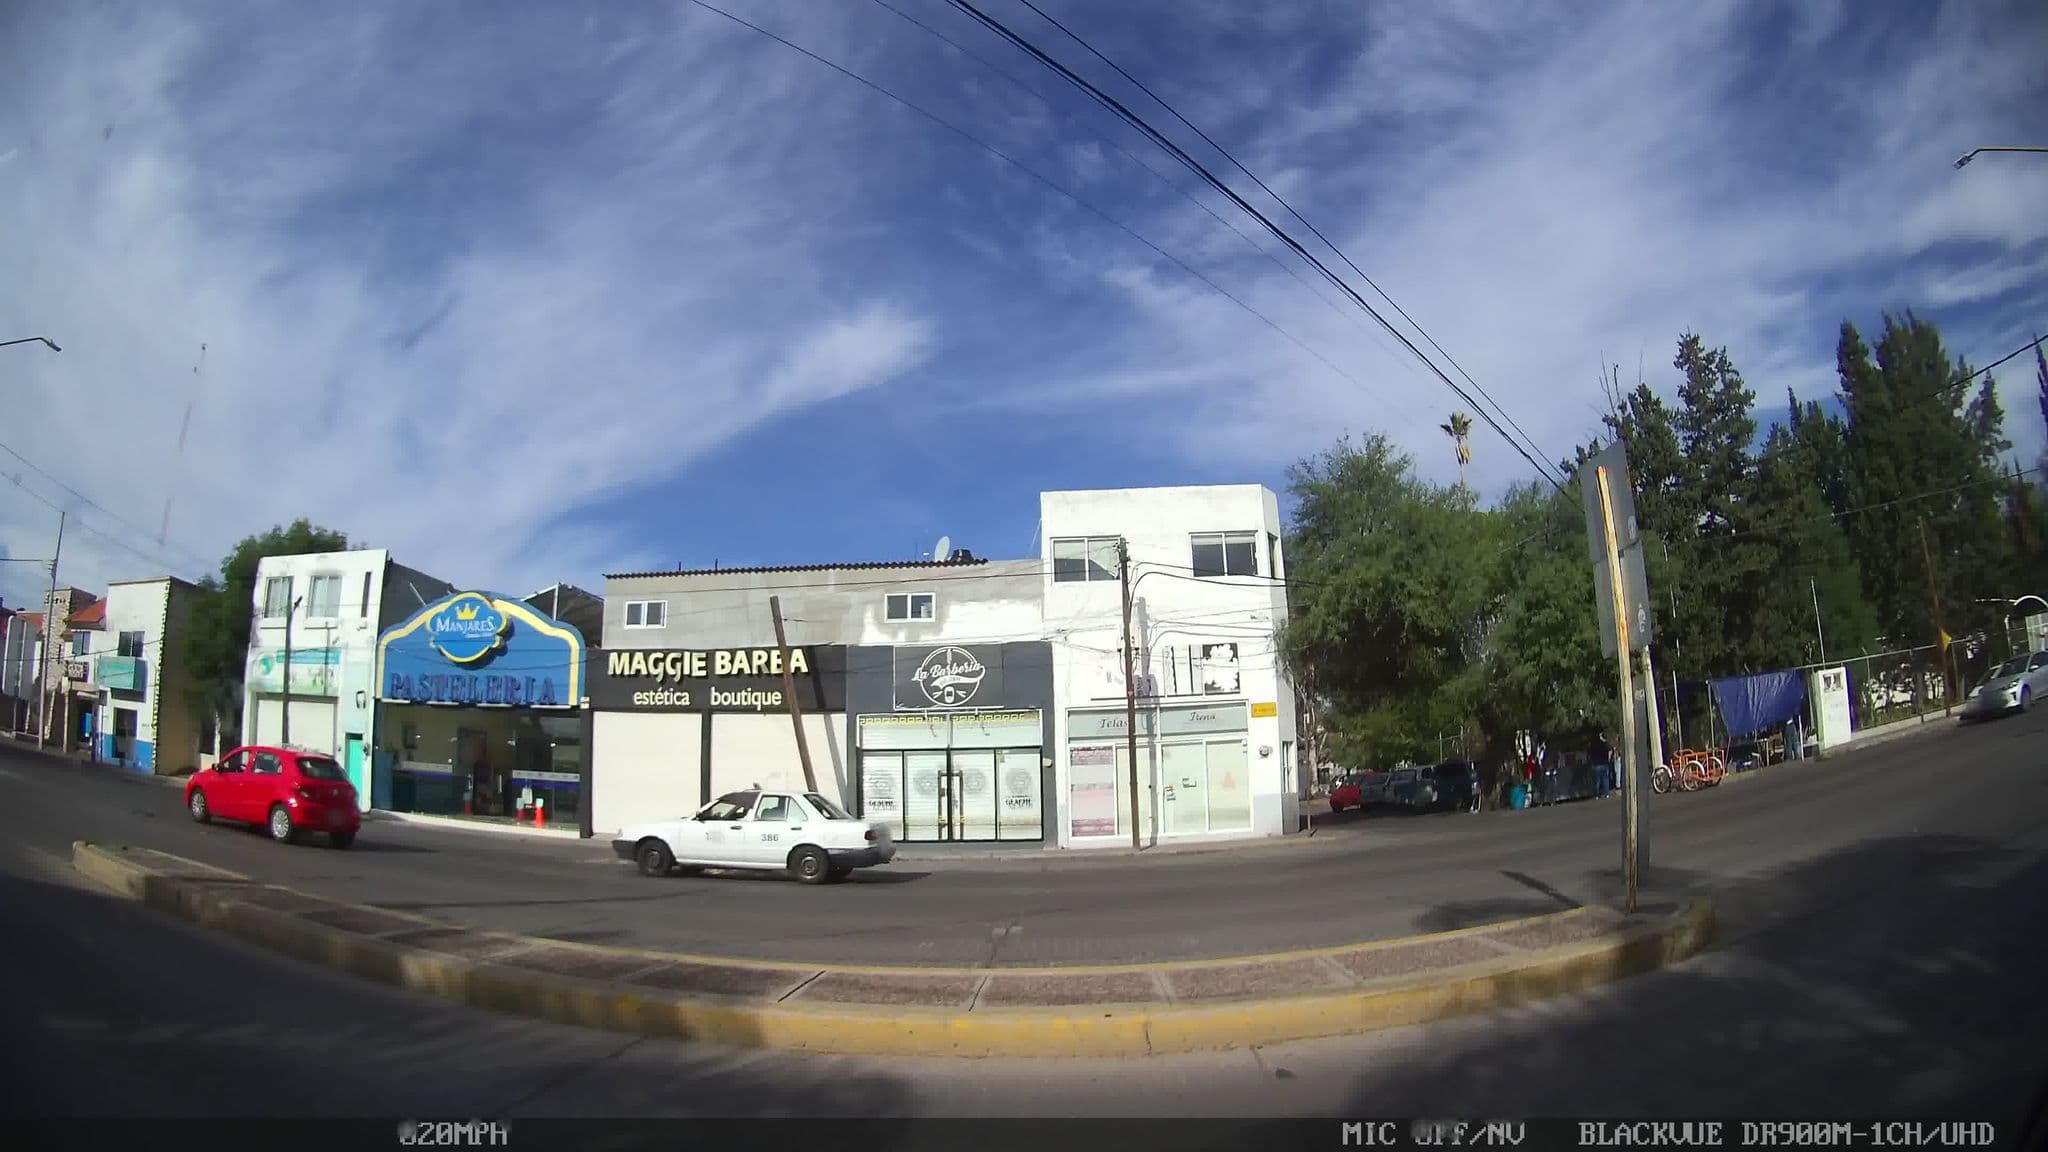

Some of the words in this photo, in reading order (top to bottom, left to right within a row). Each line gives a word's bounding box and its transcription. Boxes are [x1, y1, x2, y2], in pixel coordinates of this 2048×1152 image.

[607, 651, 707, 682] MAGGIE
[633, 686, 690, 706] estética
[710, 686, 782, 711] boutique
[761, 833, 779, 842] 386
